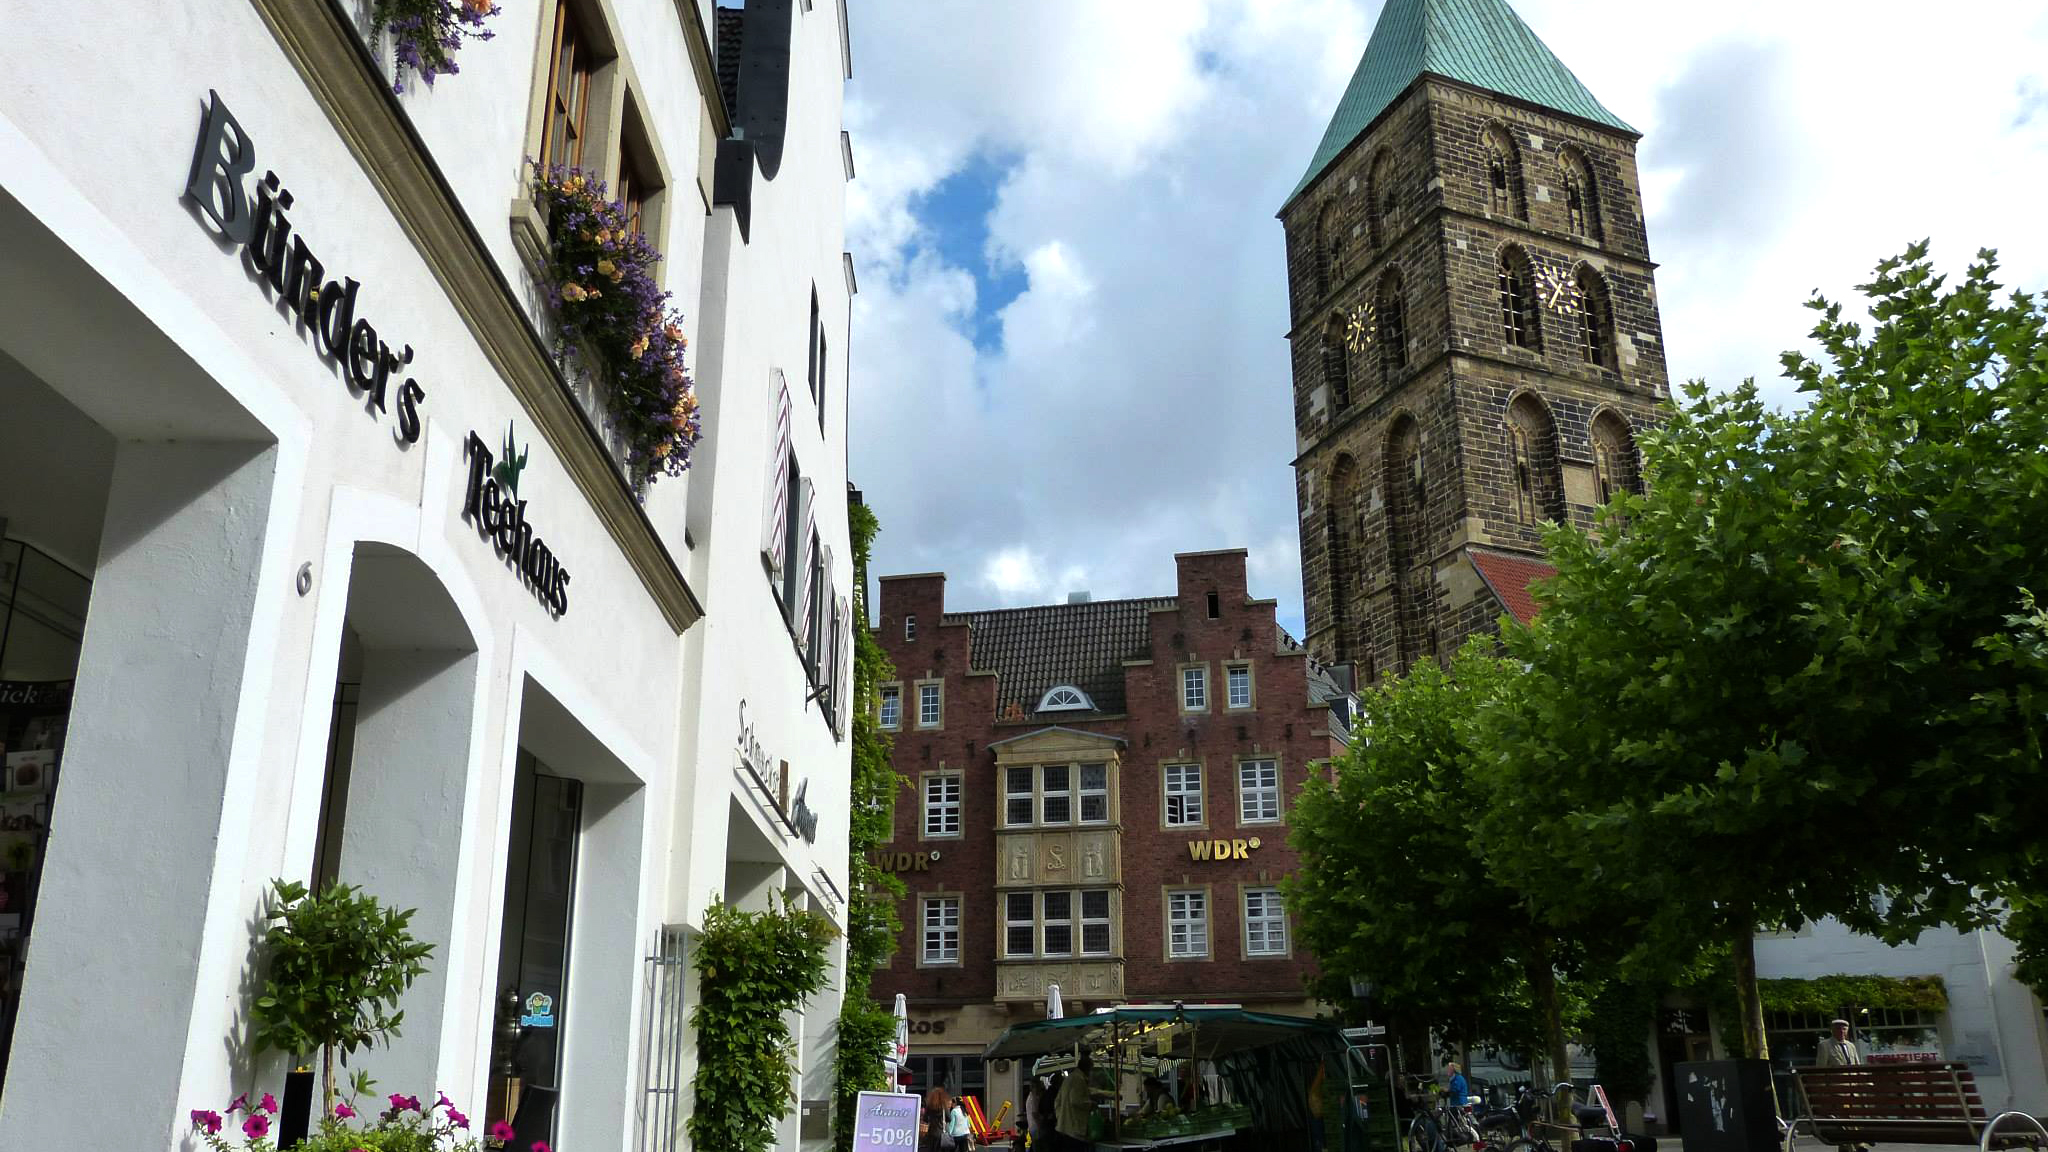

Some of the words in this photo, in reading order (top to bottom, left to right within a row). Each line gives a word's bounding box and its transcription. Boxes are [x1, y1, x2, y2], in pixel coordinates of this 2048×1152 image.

[186, 89, 425, 444] Bünder's
[468, 430, 571, 617] Teehaus
[297, 561, 312, 598] 6
[1188, 839, 1249, 861] WDR
[860, 1127, 913, 1146] -50%
